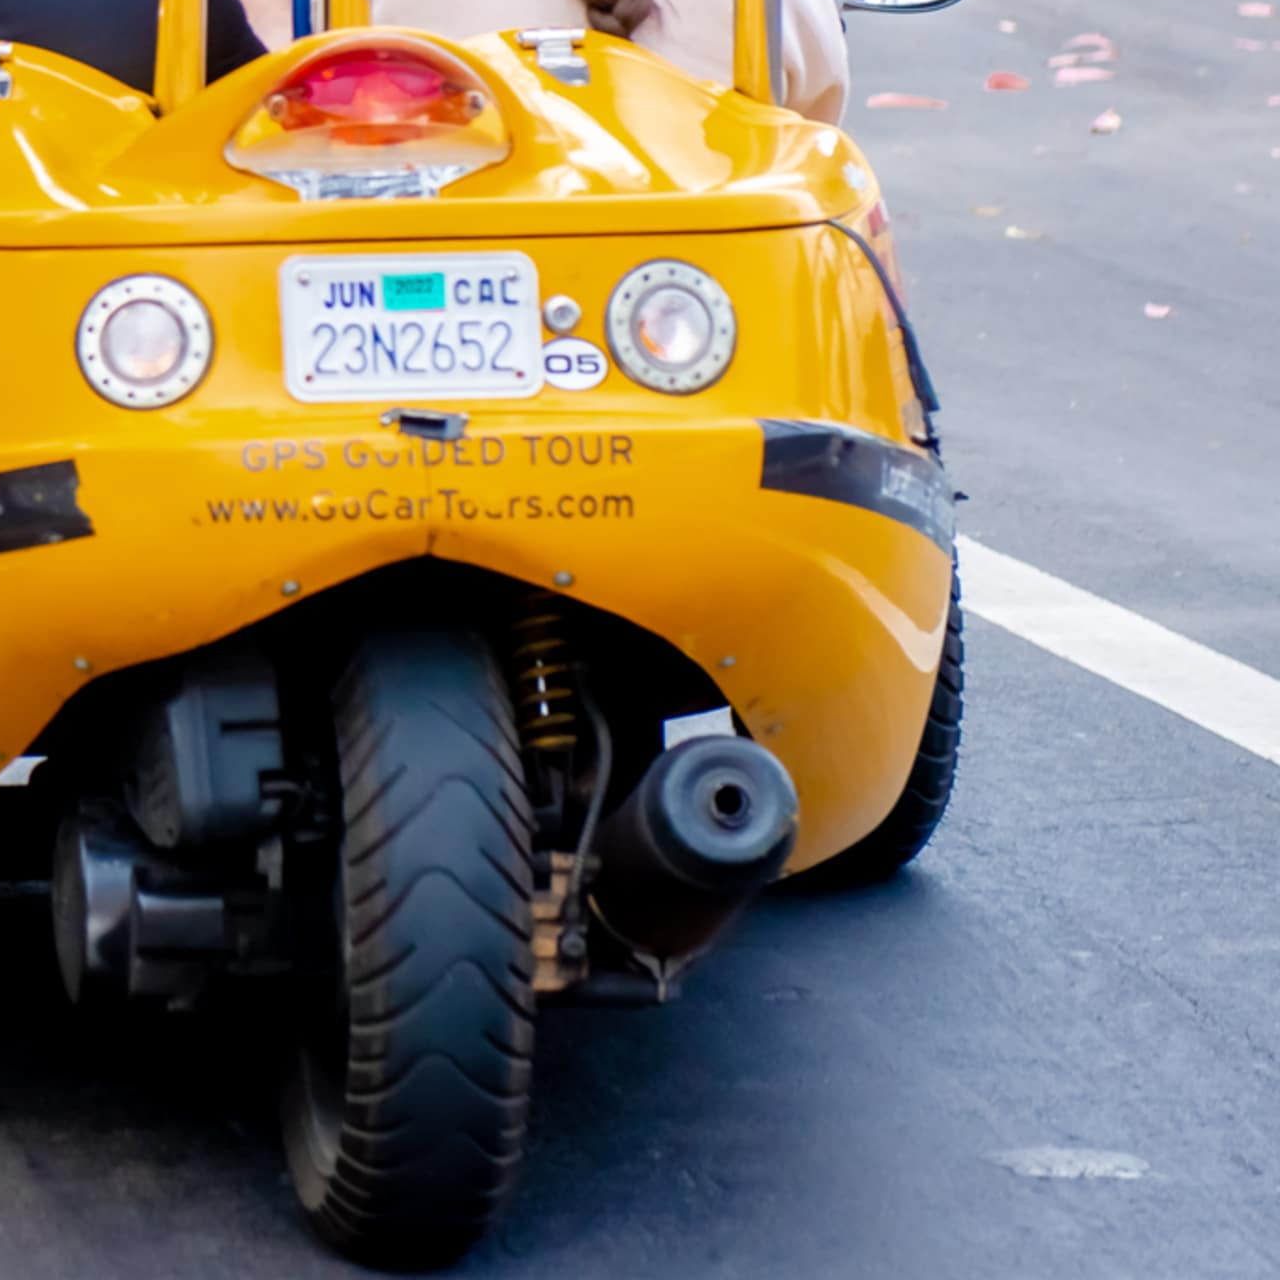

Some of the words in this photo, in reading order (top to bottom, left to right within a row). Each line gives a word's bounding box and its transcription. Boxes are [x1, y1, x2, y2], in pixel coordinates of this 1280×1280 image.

[324, 280, 376, 309] JUN
[453, 278, 520, 305] CAL
[312, 320, 516, 375] 23N2652
[544, 354, 600, 375] 05
[241, 439, 327, 472] GPS
[523, 434, 634, 466] TOUR
